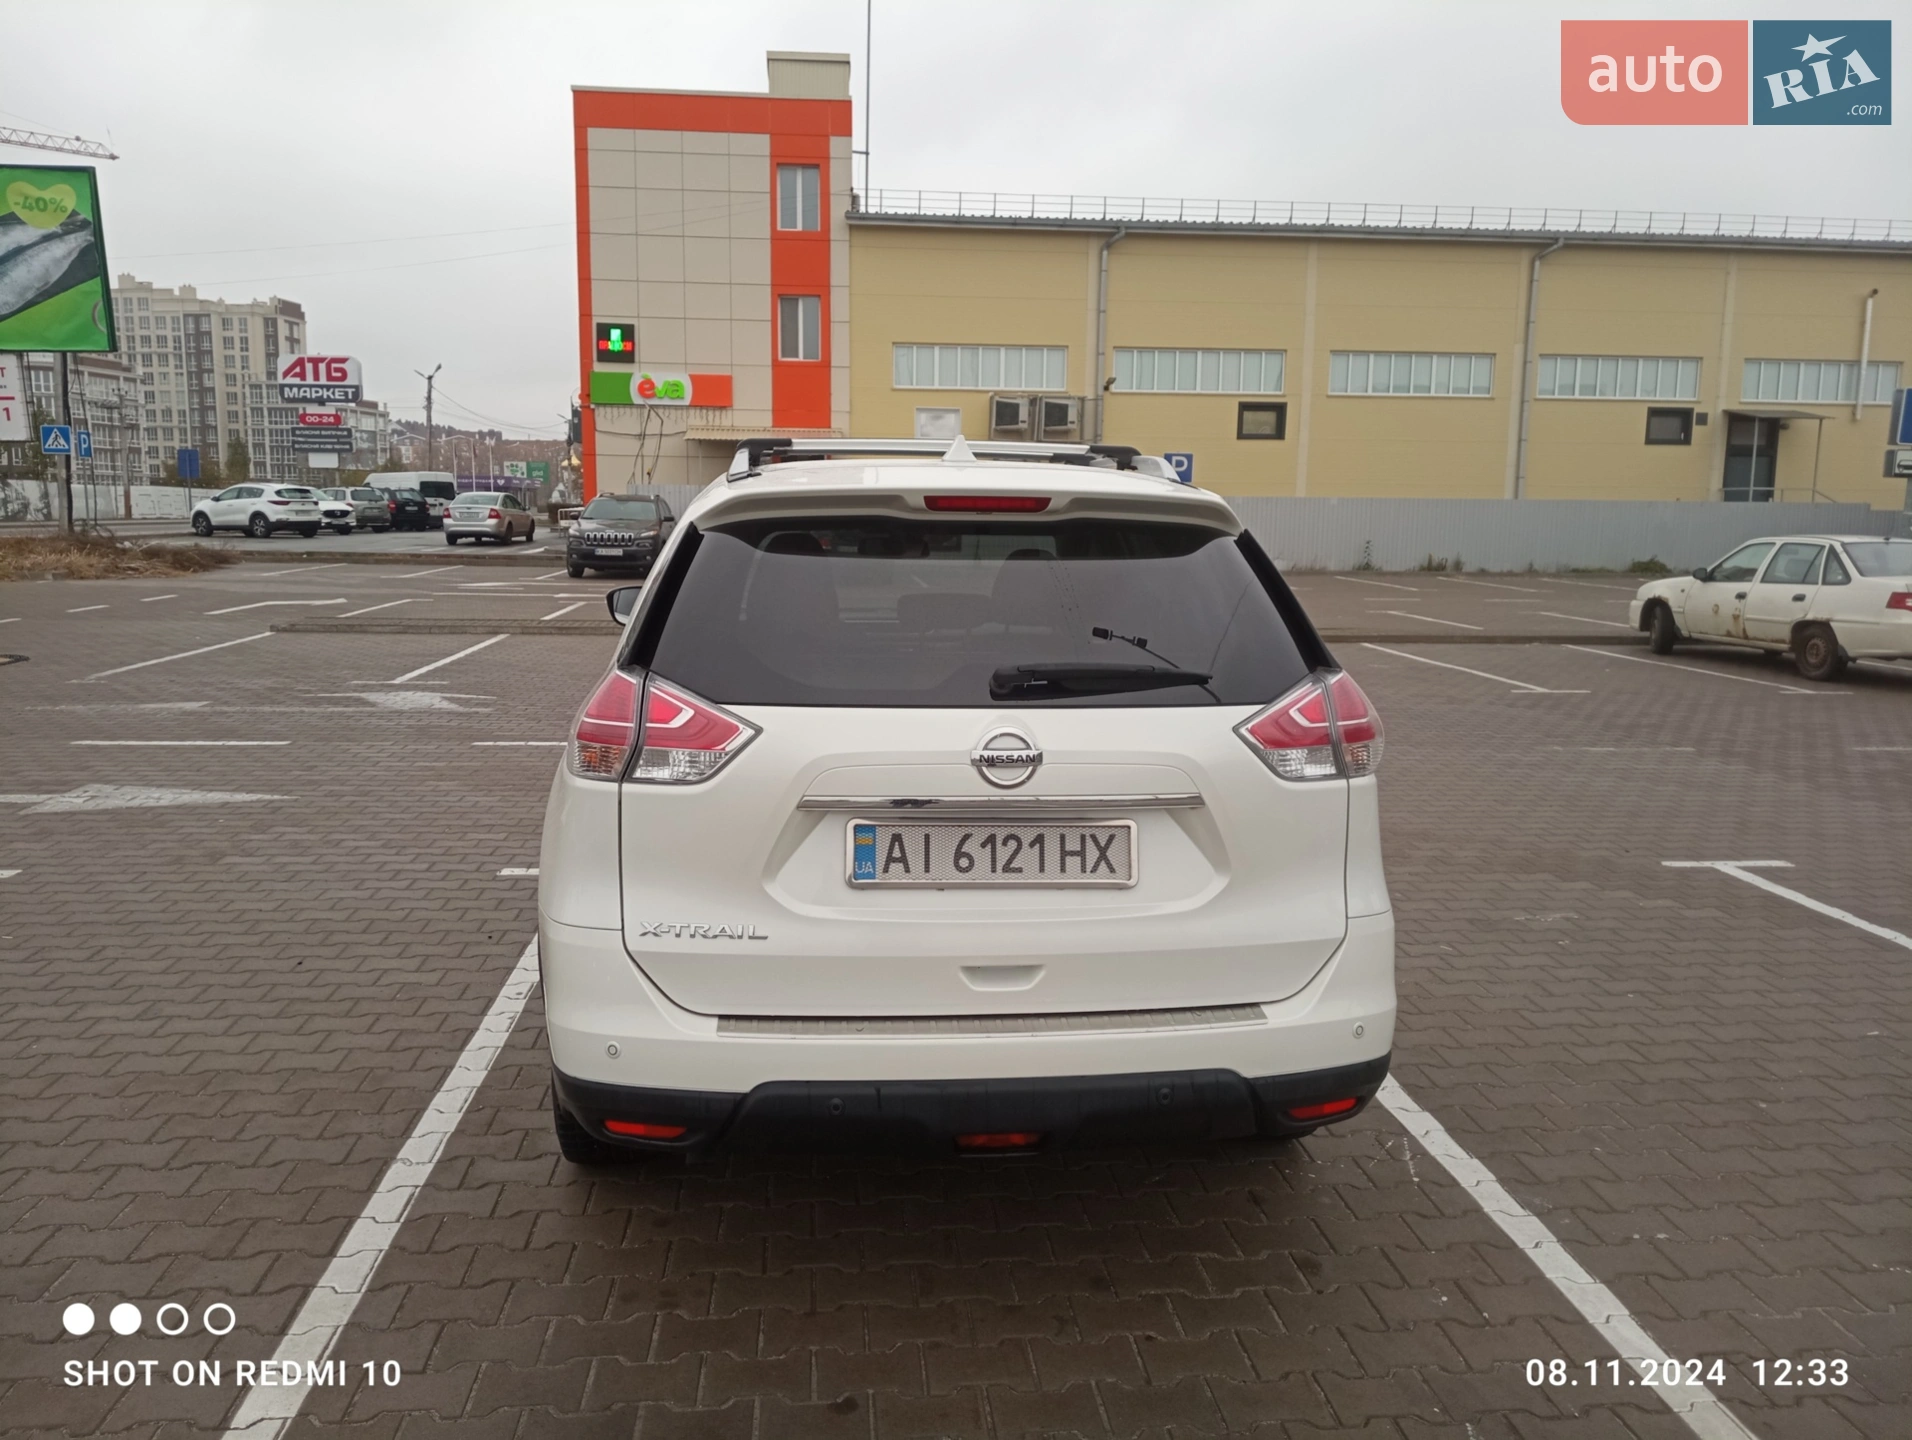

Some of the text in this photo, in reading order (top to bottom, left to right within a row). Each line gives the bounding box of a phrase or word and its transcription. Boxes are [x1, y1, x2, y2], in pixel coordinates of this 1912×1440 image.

[13, 196, 68, 213] -40%
[282, 357, 350, 382] АТБ
[283, 387, 356, 399] МАРКЕТ
[637, 373, 685, 399] eva
[305, 415, 335, 423] 00-24
[81, 434, 89, 455] P
[1171, 455, 1189, 472] P
[979, 754, 1036, 764] NISSAN
[882, 833, 1117, 874] AI 6121 HX
[855, 861, 874, 874] UA
[639, 921, 769, 940] X-TRAIL
